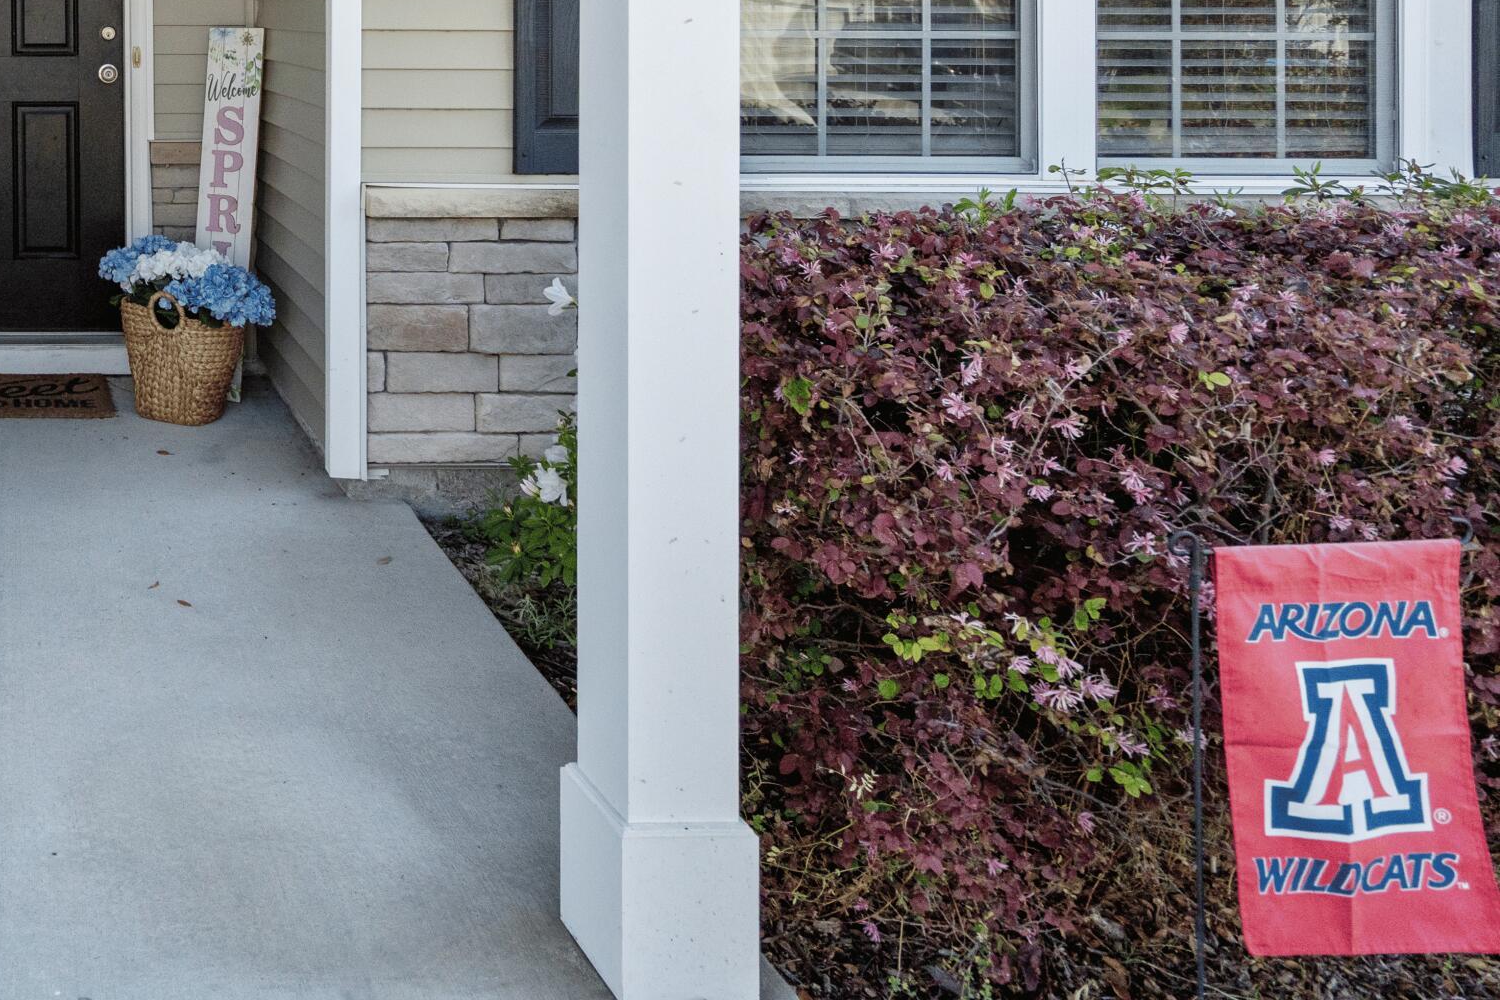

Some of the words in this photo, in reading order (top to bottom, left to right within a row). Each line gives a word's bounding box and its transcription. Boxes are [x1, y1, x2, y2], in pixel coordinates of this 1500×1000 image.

[207, 71, 258, 101] Welcome
[9, 399, 97, 409] HOME
[1246, 600, 1438, 643] ARIZONA
[1264, 658, 1433, 842] A
[1253, 853, 1461, 897] WILDCATS
